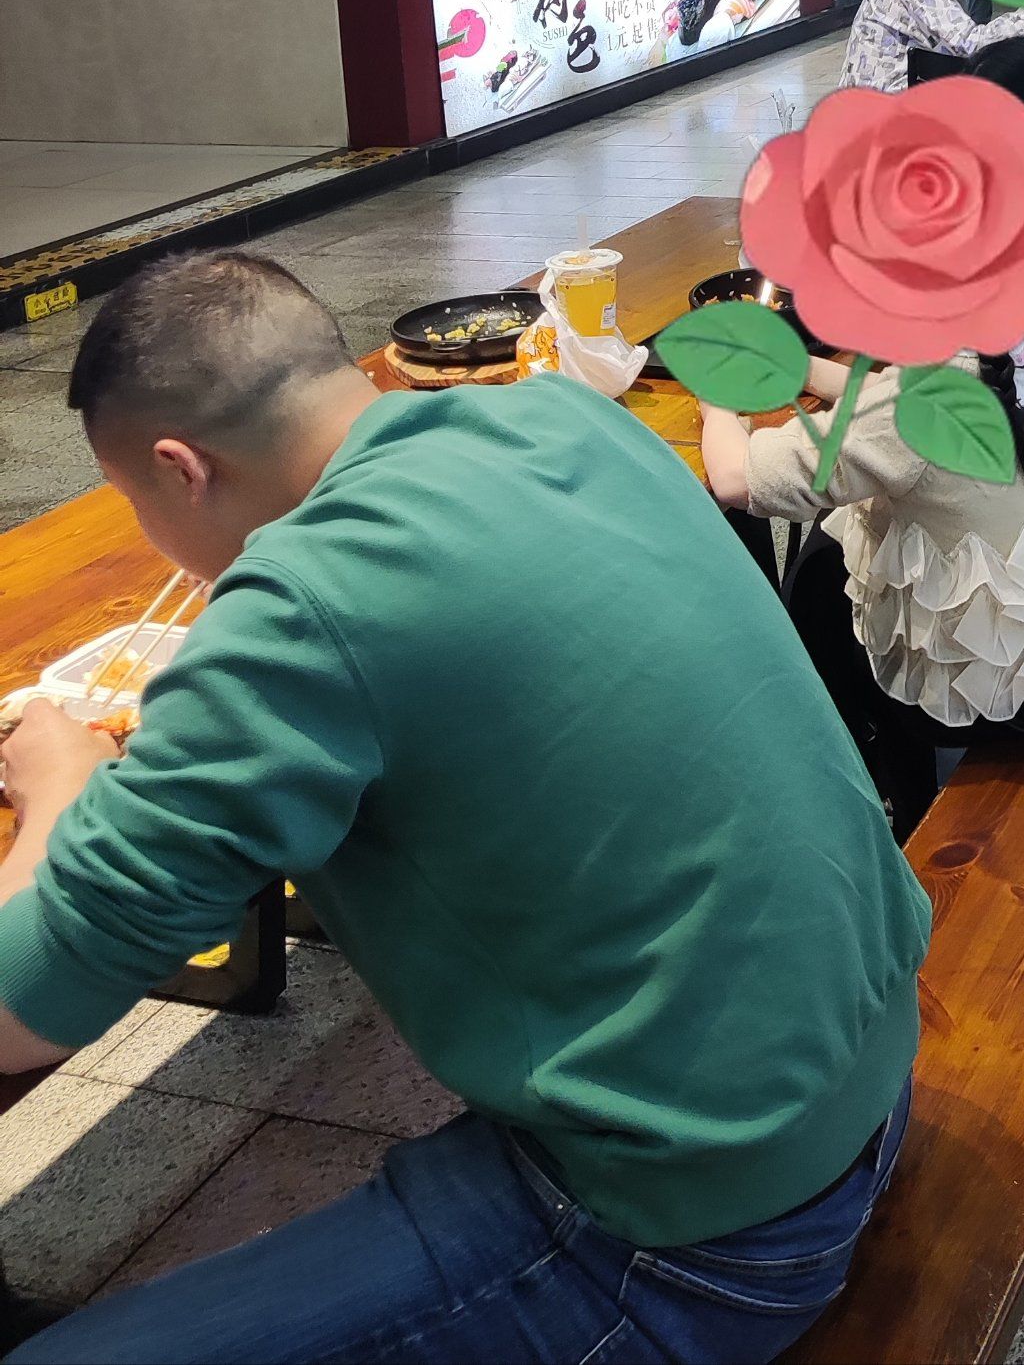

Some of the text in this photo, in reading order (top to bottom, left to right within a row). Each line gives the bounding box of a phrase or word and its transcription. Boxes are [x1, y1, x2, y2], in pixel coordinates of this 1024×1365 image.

[542, 26, 568, 42] SUSHI
[606, 18, 660, 52] 1元起售
